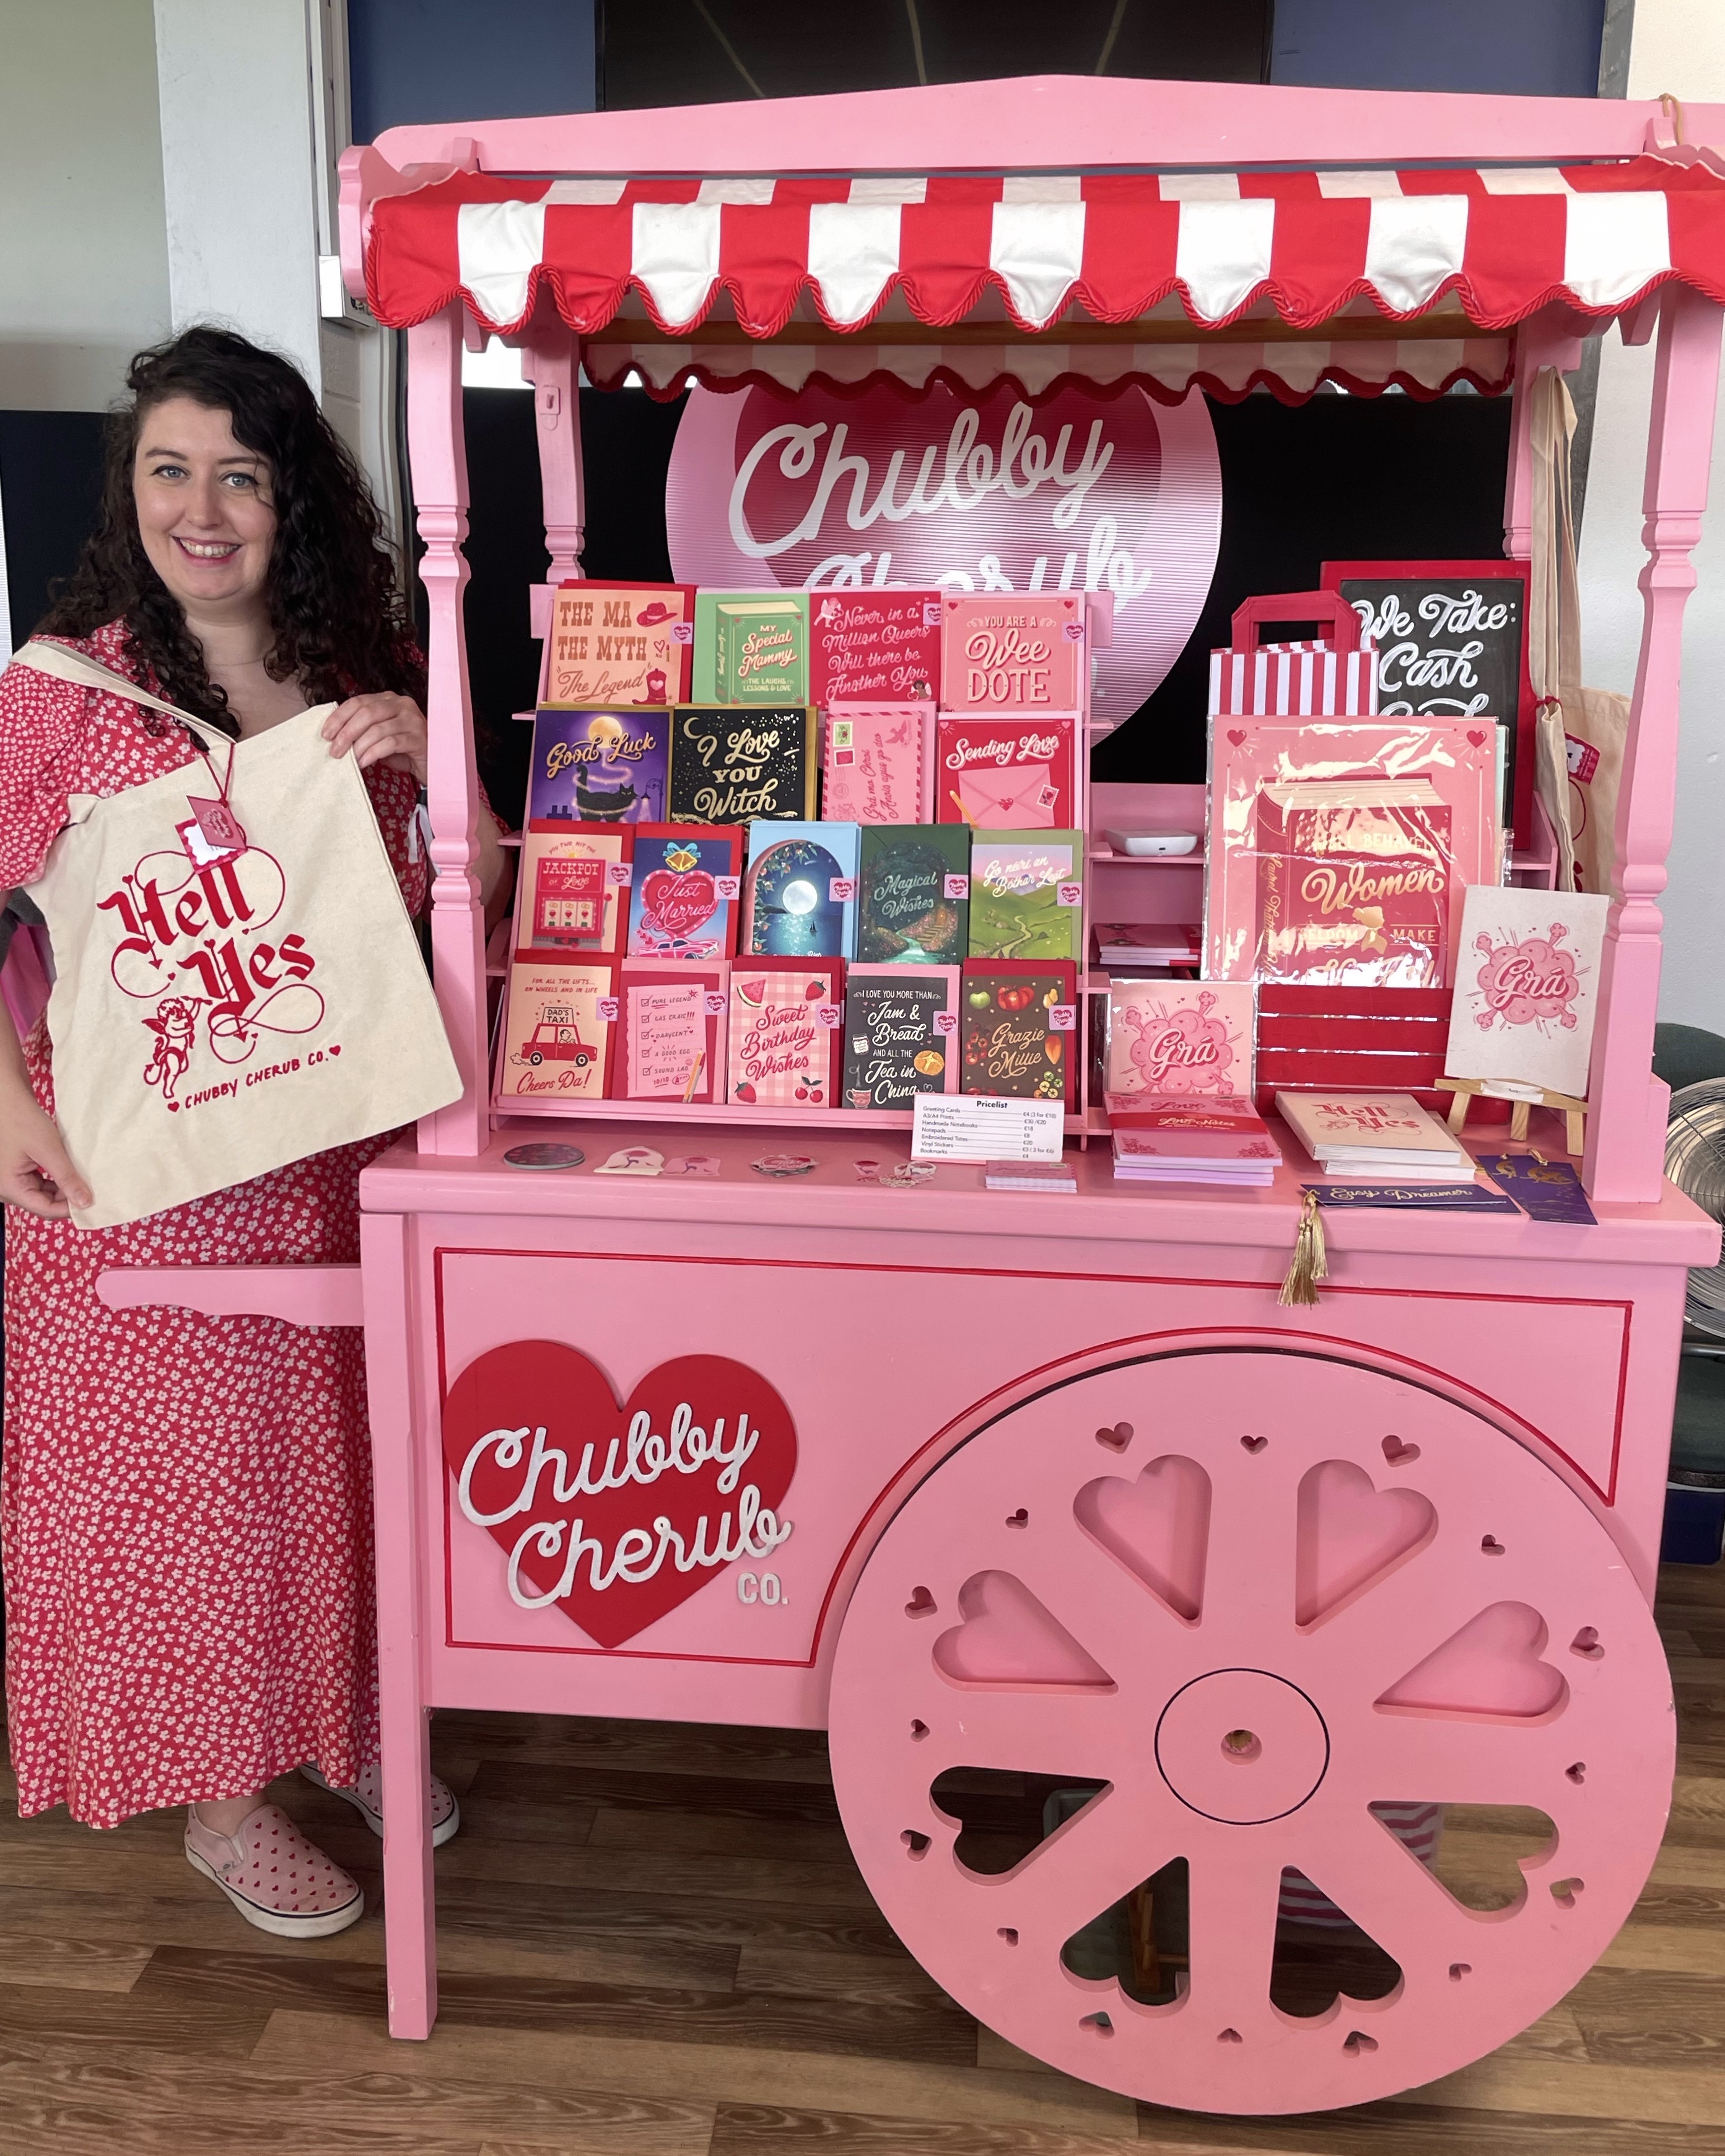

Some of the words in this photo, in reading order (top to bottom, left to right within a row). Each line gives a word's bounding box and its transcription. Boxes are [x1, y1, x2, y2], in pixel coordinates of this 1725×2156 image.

[728, 401, 1114, 558] Chubby
[560, 601, 593, 626] THE
[603, 601, 632, 627] MA
[834, 605, 884, 632] Never
[888, 608, 903, 620] in
[907, 607, 919, 619] a
[984, 616, 1004, 628] YOU
[1007, 616, 1026, 628] ARE
[1029, 616, 1038, 628] A
[1351, 595, 1415, 639] We
[1418, 590, 1516, 638] Take:
[557, 636, 588, 660] THE
[596, 636, 647, 661] MYTH
[742, 629, 793, 655] Special
[822, 631, 879, 652] Million
[881, 625, 930, 645] Queers
[965, 629, 1051, 670] Wee
[738, 649, 798, 677] Mammy
[828, 652, 865, 674] Will
[867, 650, 902, 667] there
[904, 647, 922, 661] be
[1379, 641, 1484, 692] Cash
[826, 672, 886, 701] Another
[890, 665, 928, 691] You
[967, 668, 1051, 703] DOTE
[697, 735, 717, 767] I
[724, 729, 780, 765] Love
[873, 734, 883, 748] deo
[945, 738, 1016, 770] Sending
[1016, 734, 1060, 762] Love
[546, 735, 602, 779] Good
[608, 732, 657, 763] Luck
[877, 749, 892, 762] go
[712, 766, 763, 783] YOU
[694, 778, 779, 820] Witch
[548, 844, 559, 855] YOU
[587, 846, 596, 854] THE
[543, 862, 599, 875] JACKPOT
[983, 859, 1002, 887] Go
[1033, 856, 1049, 867] an
[561, 875, 590, 890] Love
[658, 875, 701, 900] Just
[873, 872, 938, 902] Magical
[1301, 862, 1444, 914] Women
[97, 863, 255, 968] Hell
[642, 900, 714, 931] Married
[881, 897, 933, 918] Wishes
[1393, 929, 1436, 942] MAKE
[177, 932, 315, 1033] Yes
[866, 990, 881, 999] LOVE
[883, 990, 896, 999] YOU
[897, 991, 914, 999] MORE
[915, 991, 933, 999] THAN
[1493, 955, 1570, 1010] Grá
[547, 1009, 569, 1017] DAD'S
[756, 1004, 808, 1031] Sweet
[867, 1001, 906, 1026] Jam
[909, 1004, 921, 1020] &
[740, 1027, 817, 1059] Birthday
[871, 1023, 927, 1047] Bread
[988, 1022, 1045, 1058] Grazie
[745, 1052, 809, 1081] Wishes
[873, 1049, 886, 1057] AND
[887, 1049, 899, 1058] ALL
[900, 1050, 913, 1058] THE
[1149, 1028, 1220, 1080] Grá
[185, 1079, 238, 1108] CHUBBY
[245, 1059, 300, 1087] CHERUB
[308, 1051, 329, 1066] CO.
[517, 1071, 556, 1094] Cheers
[558, 1069, 592, 1091] Da!
[865, 1059, 897, 1084] Tea
[900, 1064, 917, 1079] in
[875, 1080, 920, 1104] China
[976, 1100, 1008, 1108] Pricelist
[1151, 1102, 1206, 1111] Love
[1311, 1103, 1389, 1117] Hell
[1346, 1116, 1420, 1133] Yes
[1330, 1187, 1381, 1201] Easy
[1384, 1188, 1474, 1200] Dreamer
[458, 1402, 759, 1527] Chubby
[507, 1484, 793, 1609] Cherub
[736, 1572, 790, 1606] CO.
